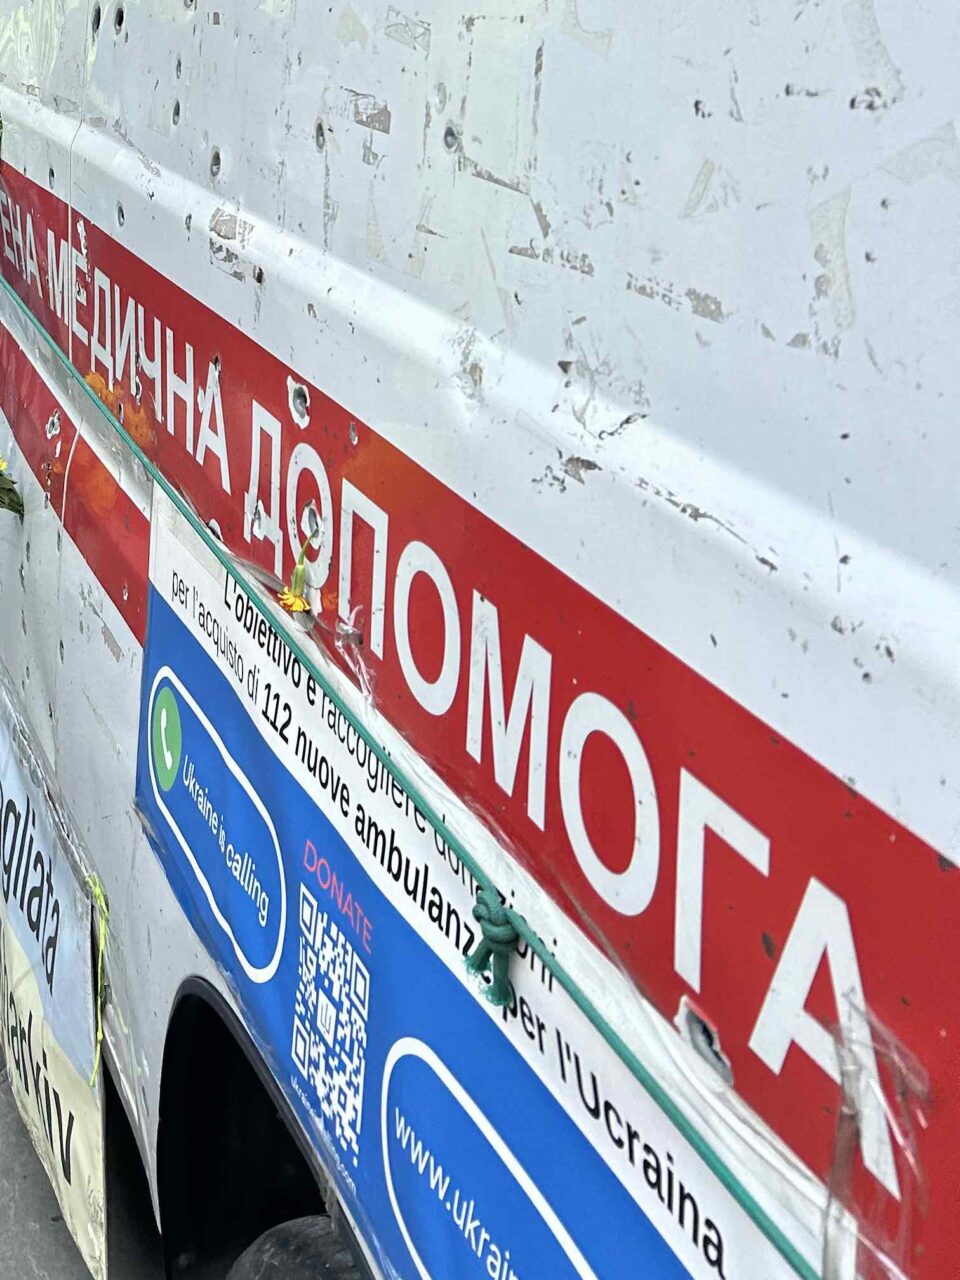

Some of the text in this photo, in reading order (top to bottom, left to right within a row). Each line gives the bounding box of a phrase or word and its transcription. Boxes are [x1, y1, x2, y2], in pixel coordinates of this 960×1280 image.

[46, 227, 232, 496] МЕДИЧНА
[243, 398, 902, 1203] ДОПОМОГА
[171, 569, 727, 1280] per l'acquisto di 112 nuove ambulanz per l'Ucraina
[182, 754, 270, 928] Ukraine is calling
[303, 839, 374, 955] DONATE
